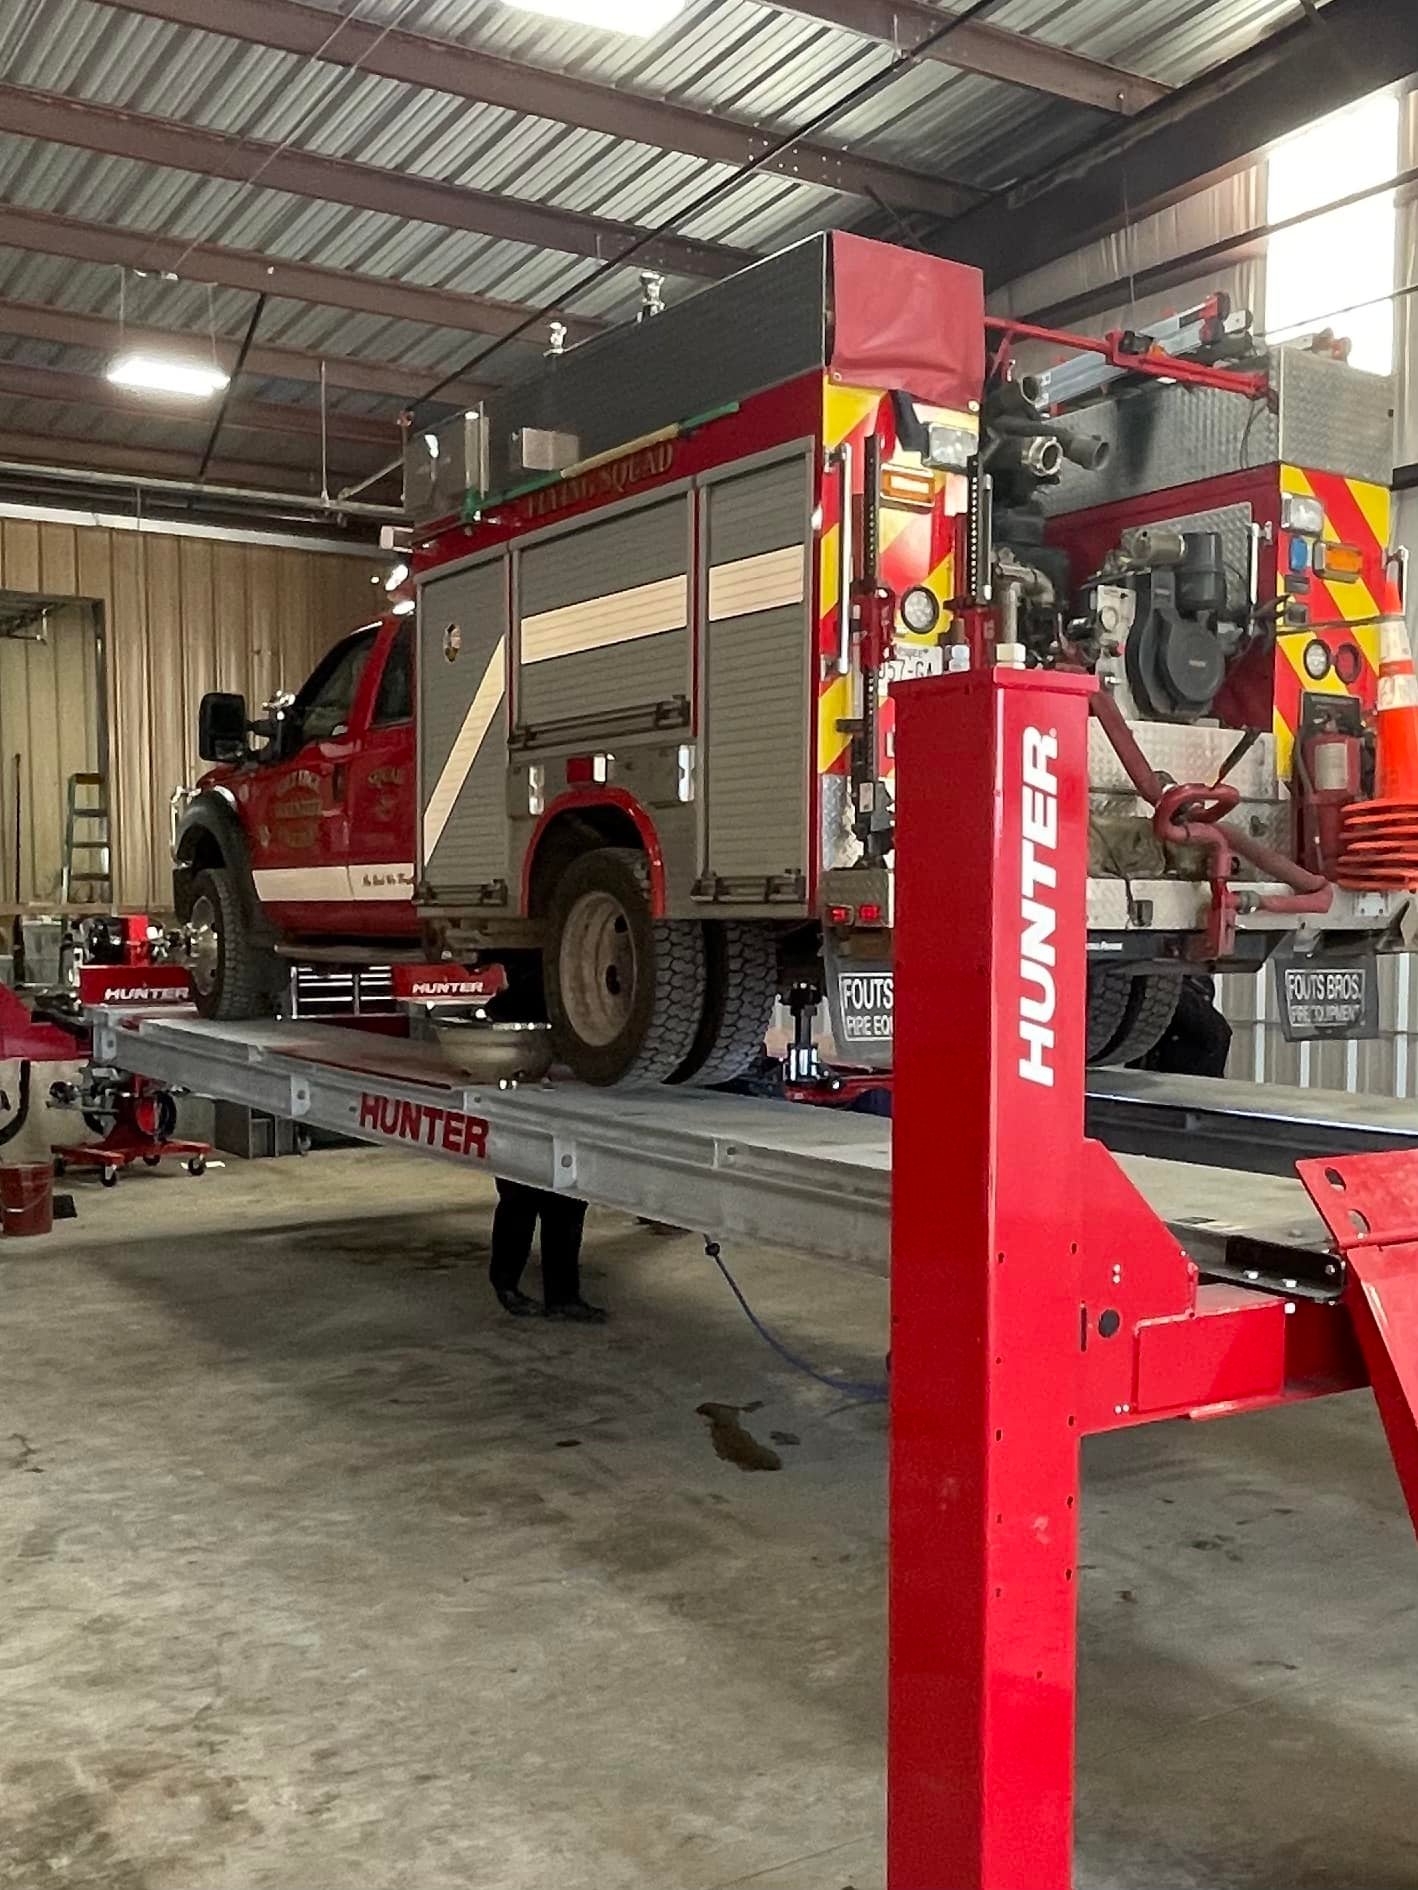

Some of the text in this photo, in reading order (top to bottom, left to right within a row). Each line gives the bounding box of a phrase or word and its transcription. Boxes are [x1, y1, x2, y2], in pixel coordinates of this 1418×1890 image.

[601, 443, 673, 493] SQUAD
[1018, 726, 1058, 1088] HUNTER
[104, 986, 190, 1001] HUNTER
[412, 982, 484, 994] HUNTER
[842, 978, 894, 1010] FOUTS
[1288, 974, 1325, 1000] FOUTS
[359, 1092, 489, 1159] HUNTER
